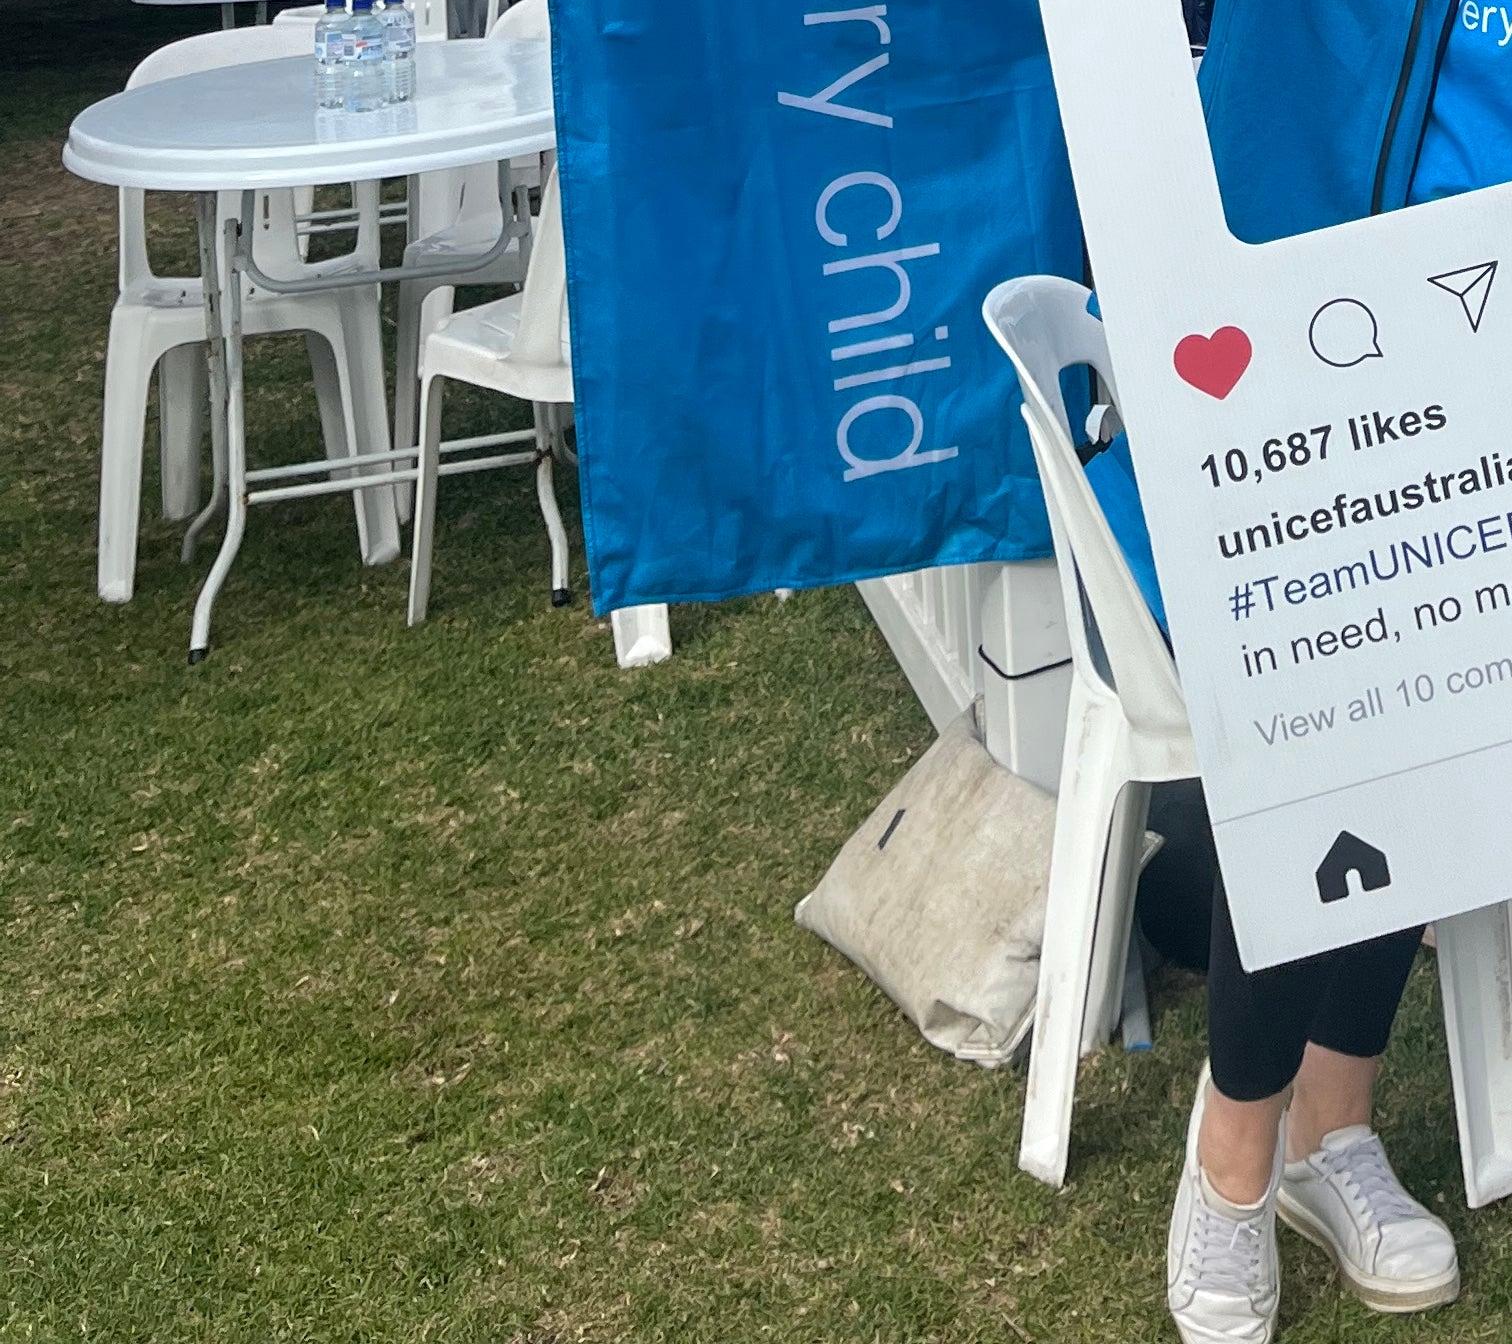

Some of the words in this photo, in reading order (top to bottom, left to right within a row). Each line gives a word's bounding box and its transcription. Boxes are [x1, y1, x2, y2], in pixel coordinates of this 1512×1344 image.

[814, 171, 958, 483] child
[1201, 425, 1333, 487] 10,687
[1348, 404, 1448, 452] likes
[1242, 643, 1277, 678] in
[1291, 608, 1402, 665] need,
[1414, 595, 1462, 631] no
[1253, 705, 1335, 746] View
[1348, 688, 1383, 722] all
[1396, 674, 1435, 709] 10
